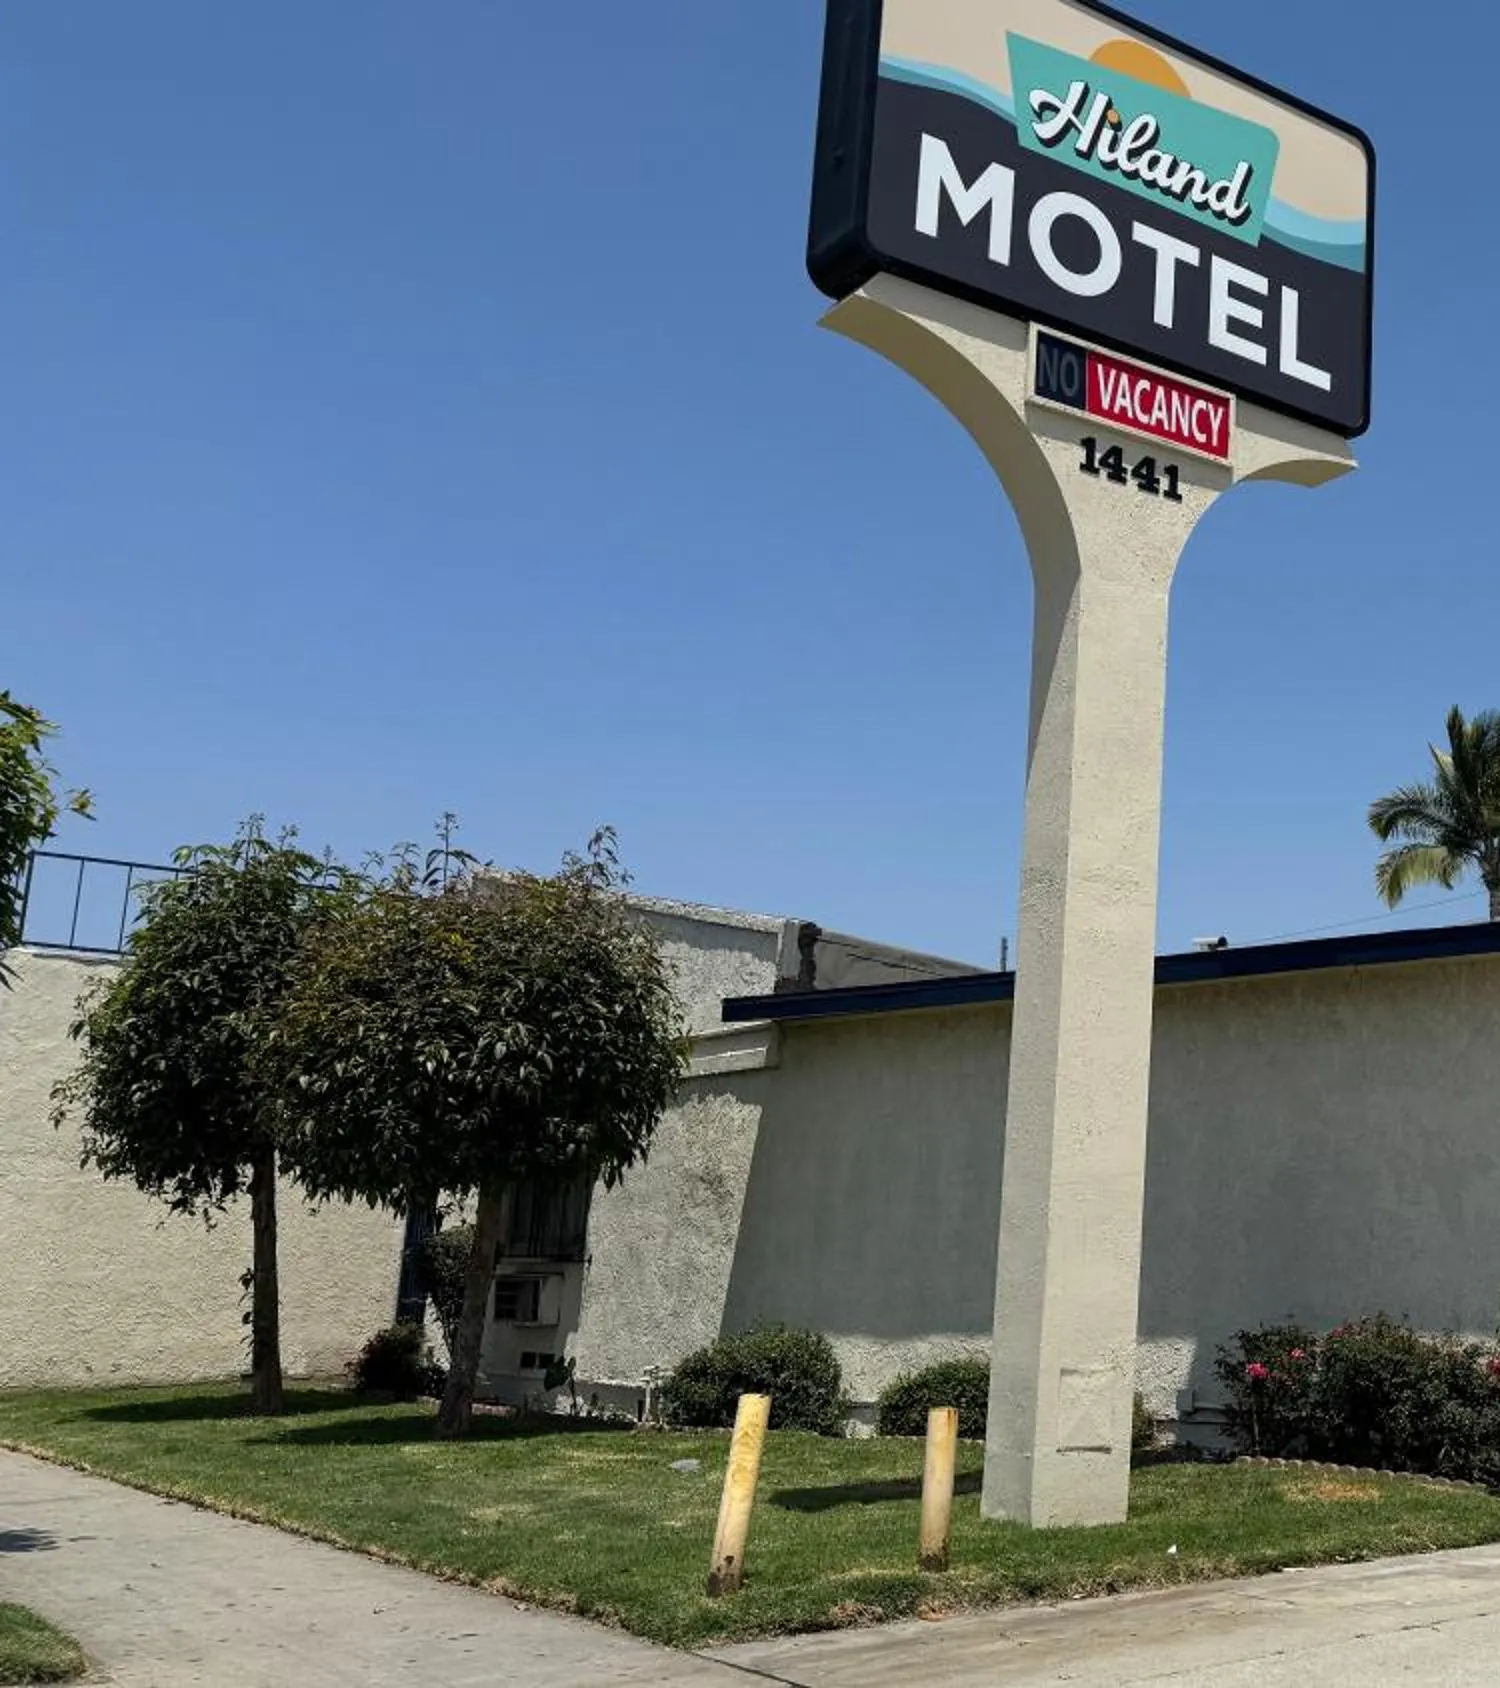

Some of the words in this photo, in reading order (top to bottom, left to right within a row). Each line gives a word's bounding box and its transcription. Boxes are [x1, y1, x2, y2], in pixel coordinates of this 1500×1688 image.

[1029, 81, 1252, 226] Hiland
[915, 133, 1331, 391] MOTEL
[1039, 343, 1080, 397] NO
[1097, 363, 1224, 447] VACANCY
[1080, 436, 1182, 503] 1441
